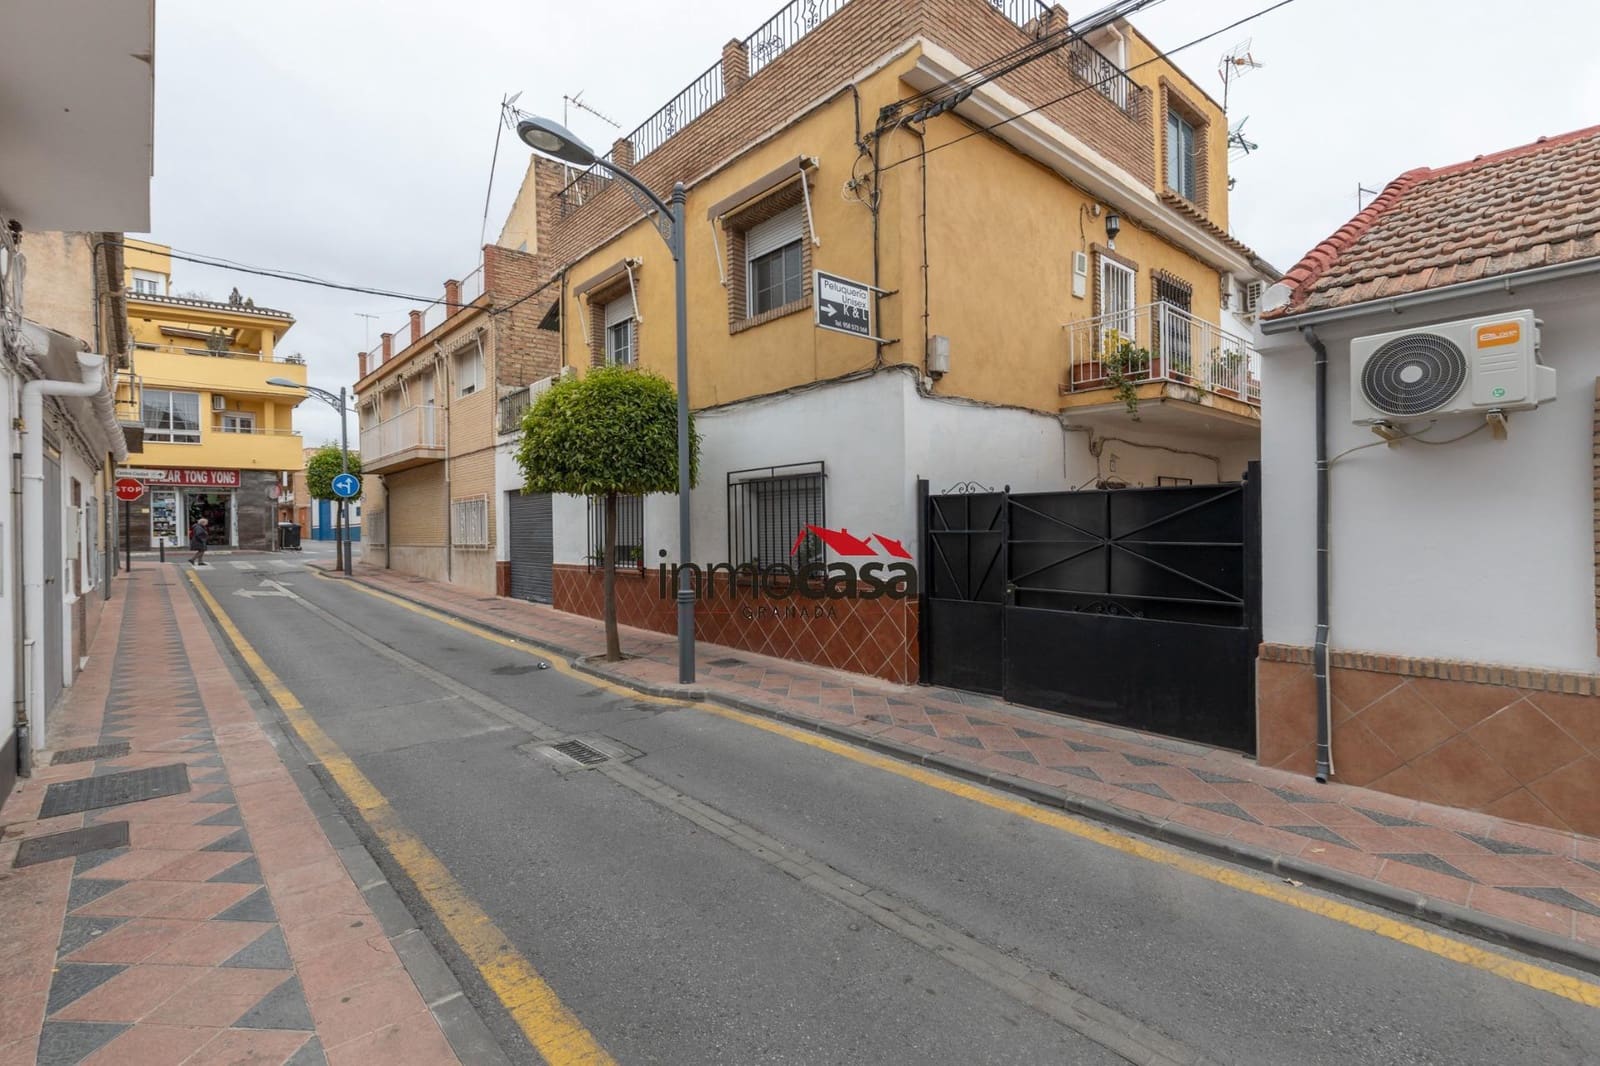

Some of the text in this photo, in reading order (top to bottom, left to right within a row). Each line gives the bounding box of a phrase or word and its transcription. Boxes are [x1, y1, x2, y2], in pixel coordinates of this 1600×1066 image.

[843, 303, 868, 321] K & L
[184, 470, 208, 483] TONG
[211, 471, 236, 484] YONG
